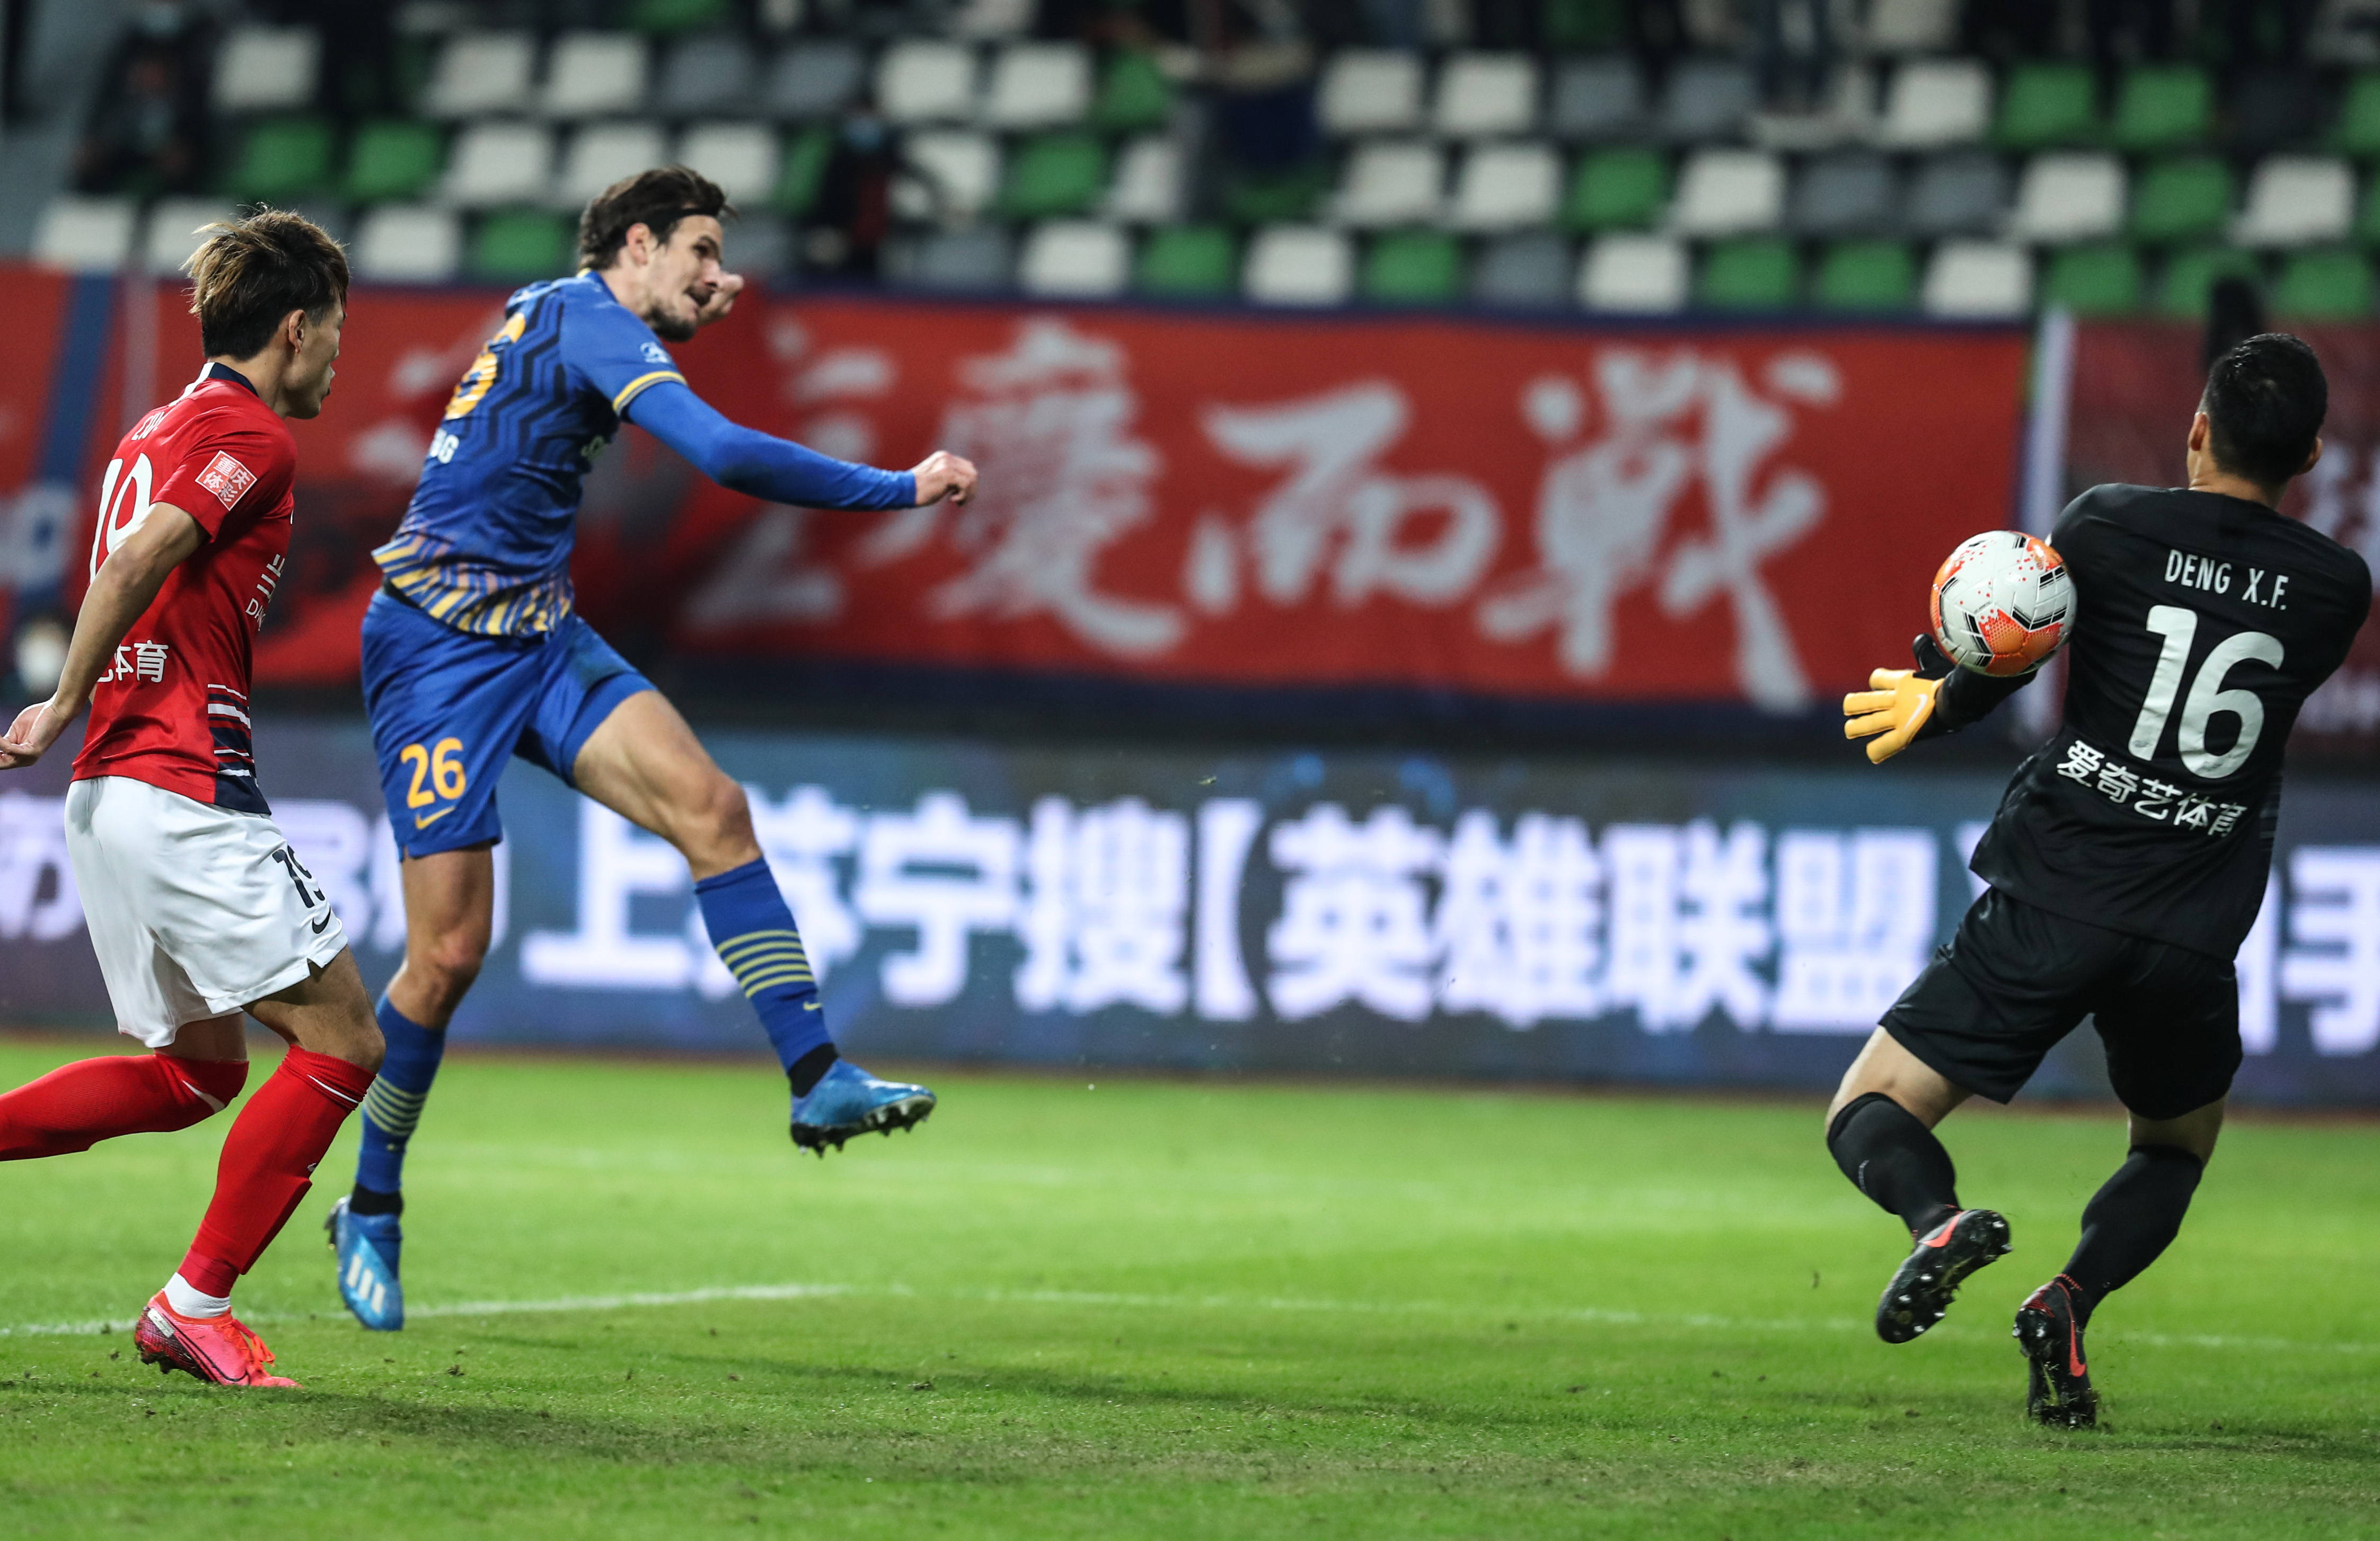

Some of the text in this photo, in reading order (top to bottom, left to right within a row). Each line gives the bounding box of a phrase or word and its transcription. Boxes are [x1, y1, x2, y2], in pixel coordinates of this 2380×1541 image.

[213, 456, 251, 490] 重庆
[2164, 549, 2289, 610] DENG X.F.
[2128, 604, 2285, 779] 16
[400, 736, 466, 809] 26
[2056, 739, 2248, 837] 爱奇艺体育
